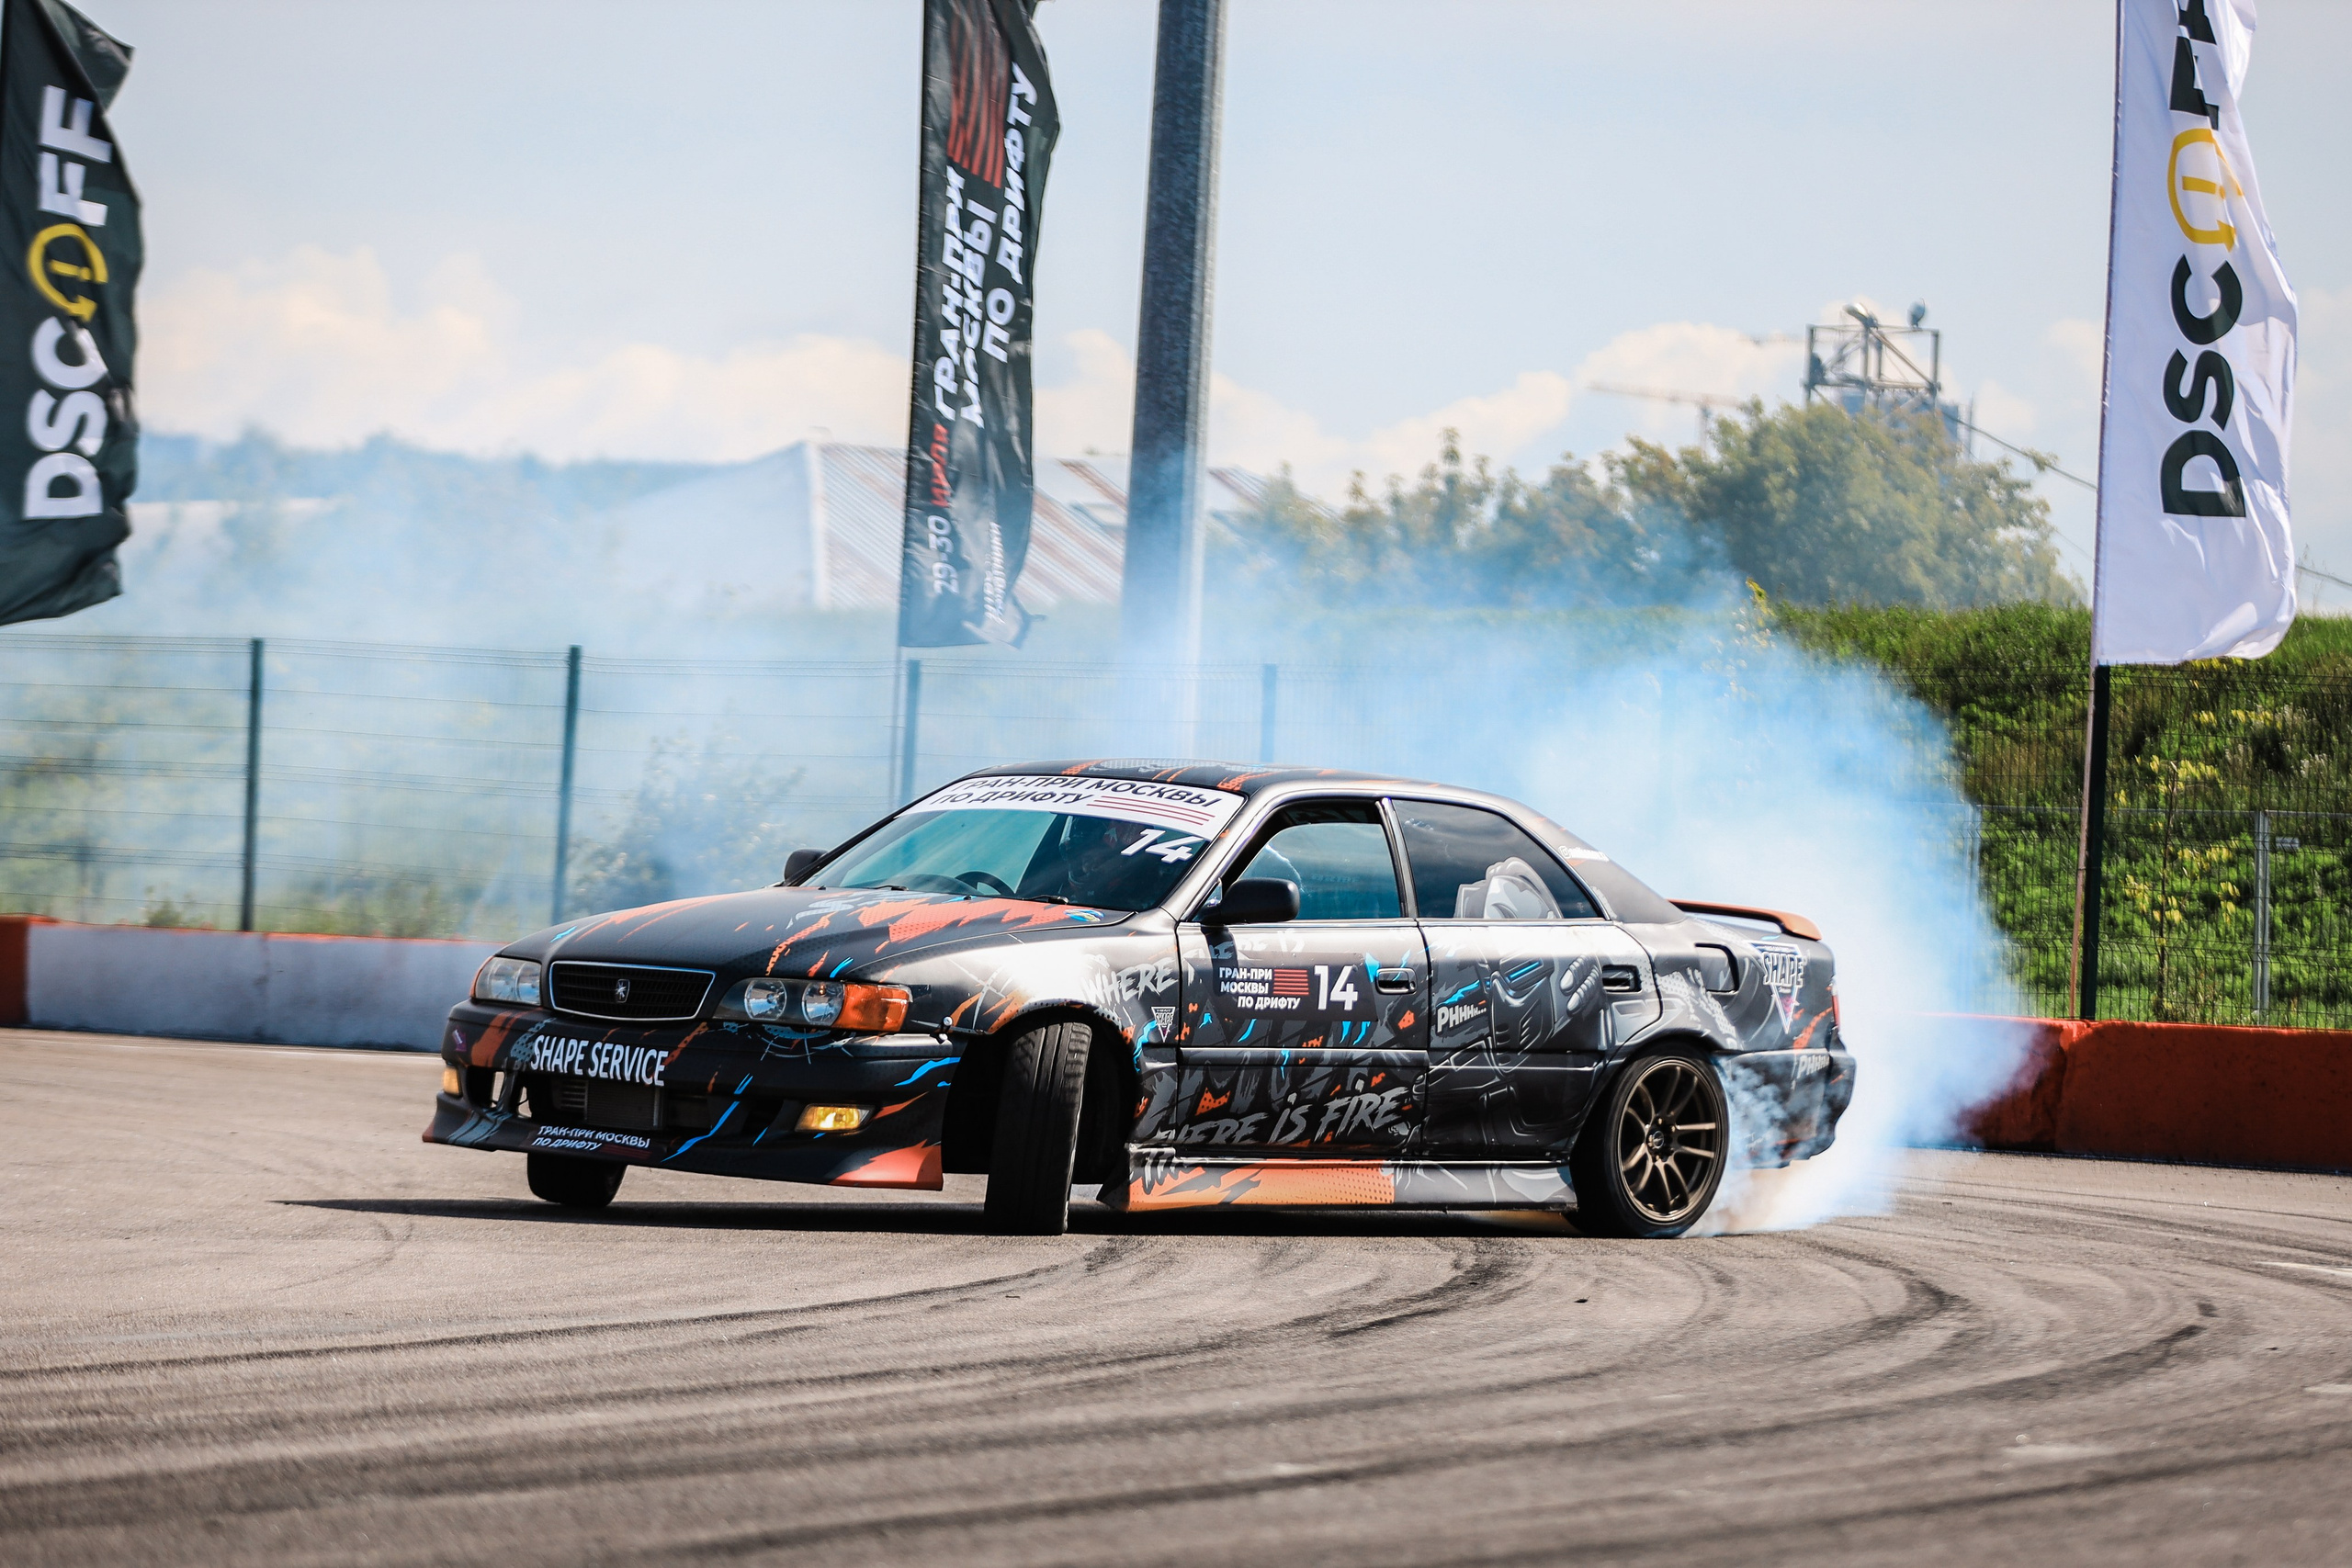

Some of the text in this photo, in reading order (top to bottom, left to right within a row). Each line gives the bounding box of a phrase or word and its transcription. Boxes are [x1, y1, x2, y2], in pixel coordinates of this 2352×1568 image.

[981, 62, 1038, 364] ПО ДРИФТУ
[933, 165, 966, 421] ГРАН-ПРИ
[927, 514, 959, 595] 29-30
[930, 791, 1094, 805] ПО ДРИФТУ
[952, 776, 1222, 807] ГРАН-ПРИ МОСКВЫ
[1121, 829, 1204, 864] 14
[1080, 957, 1179, 1007] WHERE
[1219, 967, 1272, 980] ГРАН-ПРИ
[1220, 981, 1269, 994] МОСКВЫ
[1314, 964, 1359, 1011] 14
[1762, 952, 1804, 988] SHAPE
[1155, 1012, 1173, 1026] SHAPE
[1238, 997, 1301, 1010] ПО ДРИФТУ
[530, 1034, 669, 1086] SHAPE SERVICE
[1269, 1102, 1313, 1145] IS
[1314, 1086, 1408, 1142] FIRE
[532, 1137, 603, 1151] ПО ДРИФТУ
[537, 1125, 650, 1148] ГРАН-ПРИ МОСКВЫ
